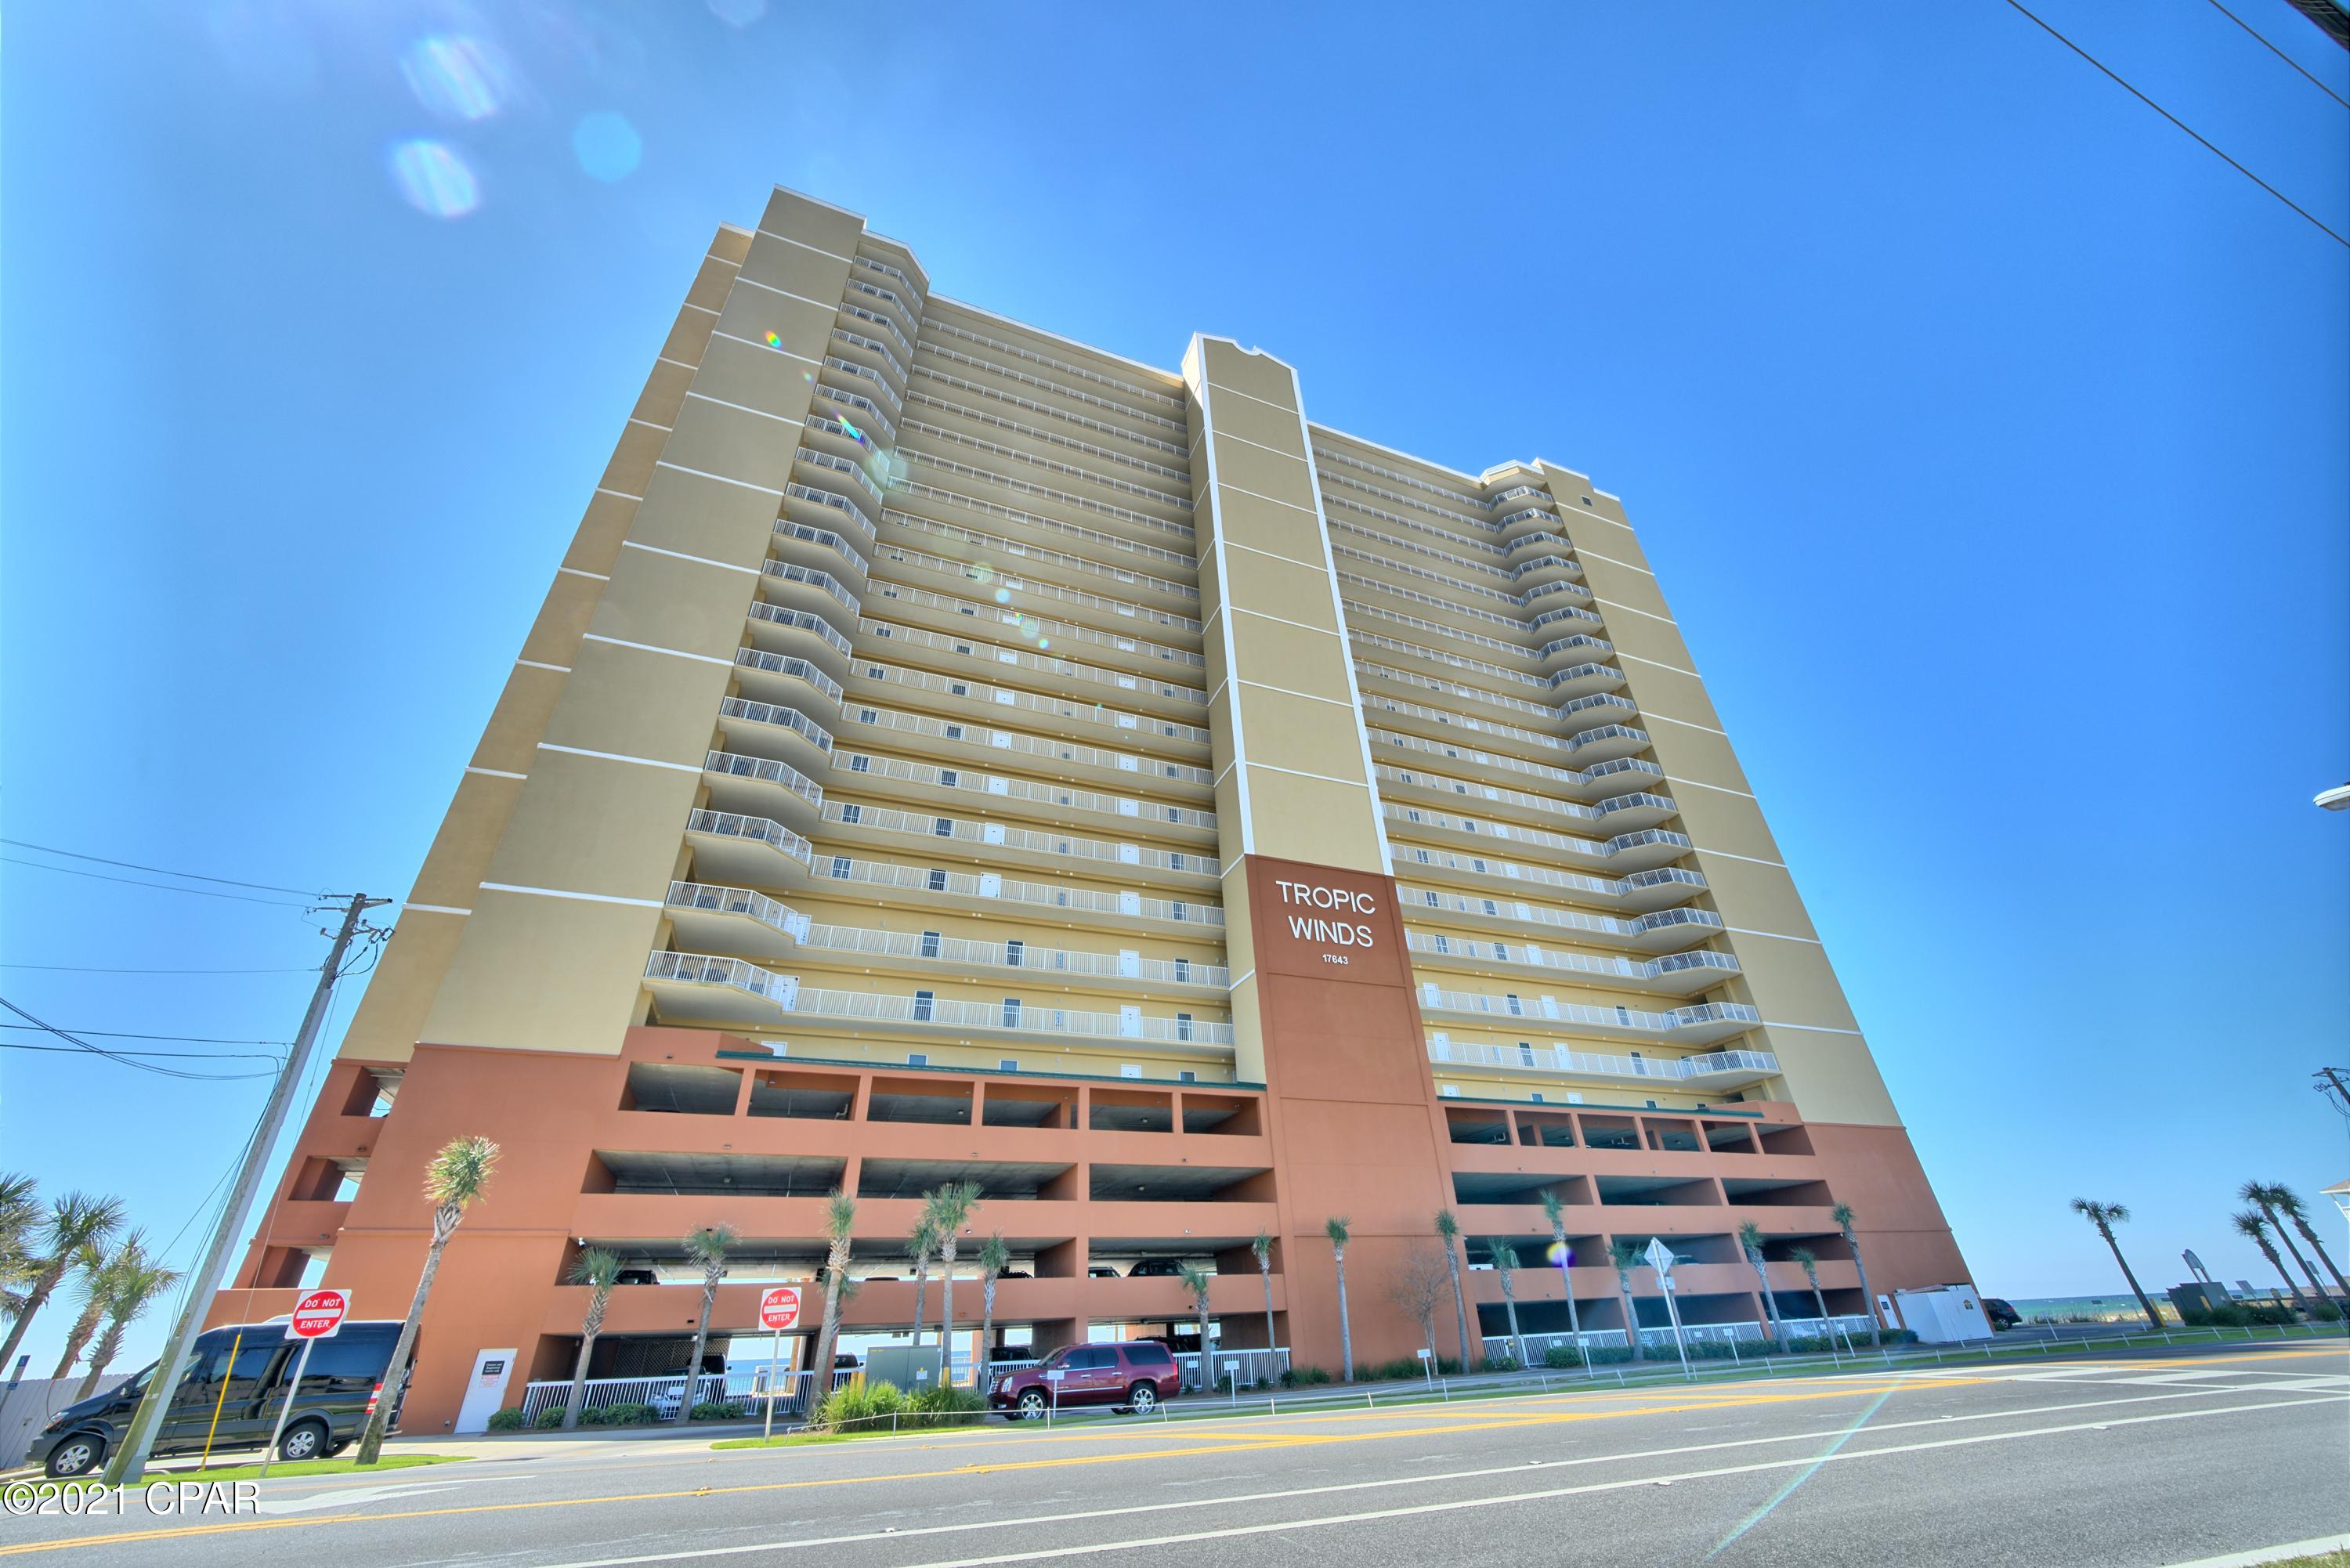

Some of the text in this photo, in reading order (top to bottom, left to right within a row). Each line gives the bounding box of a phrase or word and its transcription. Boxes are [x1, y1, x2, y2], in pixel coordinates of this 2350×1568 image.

[1275, 880, 1376, 915] TROPIC
[1288, 915, 1374, 948] WINDS
[1322, 953, 1349, 965] 17643
[304, 1298, 342, 1308] DO NOT
[781, 1295, 795, 1303] NOT
[768, 1313, 790, 1322] ENTER
[300, 1319, 331, 1329] ENTER
